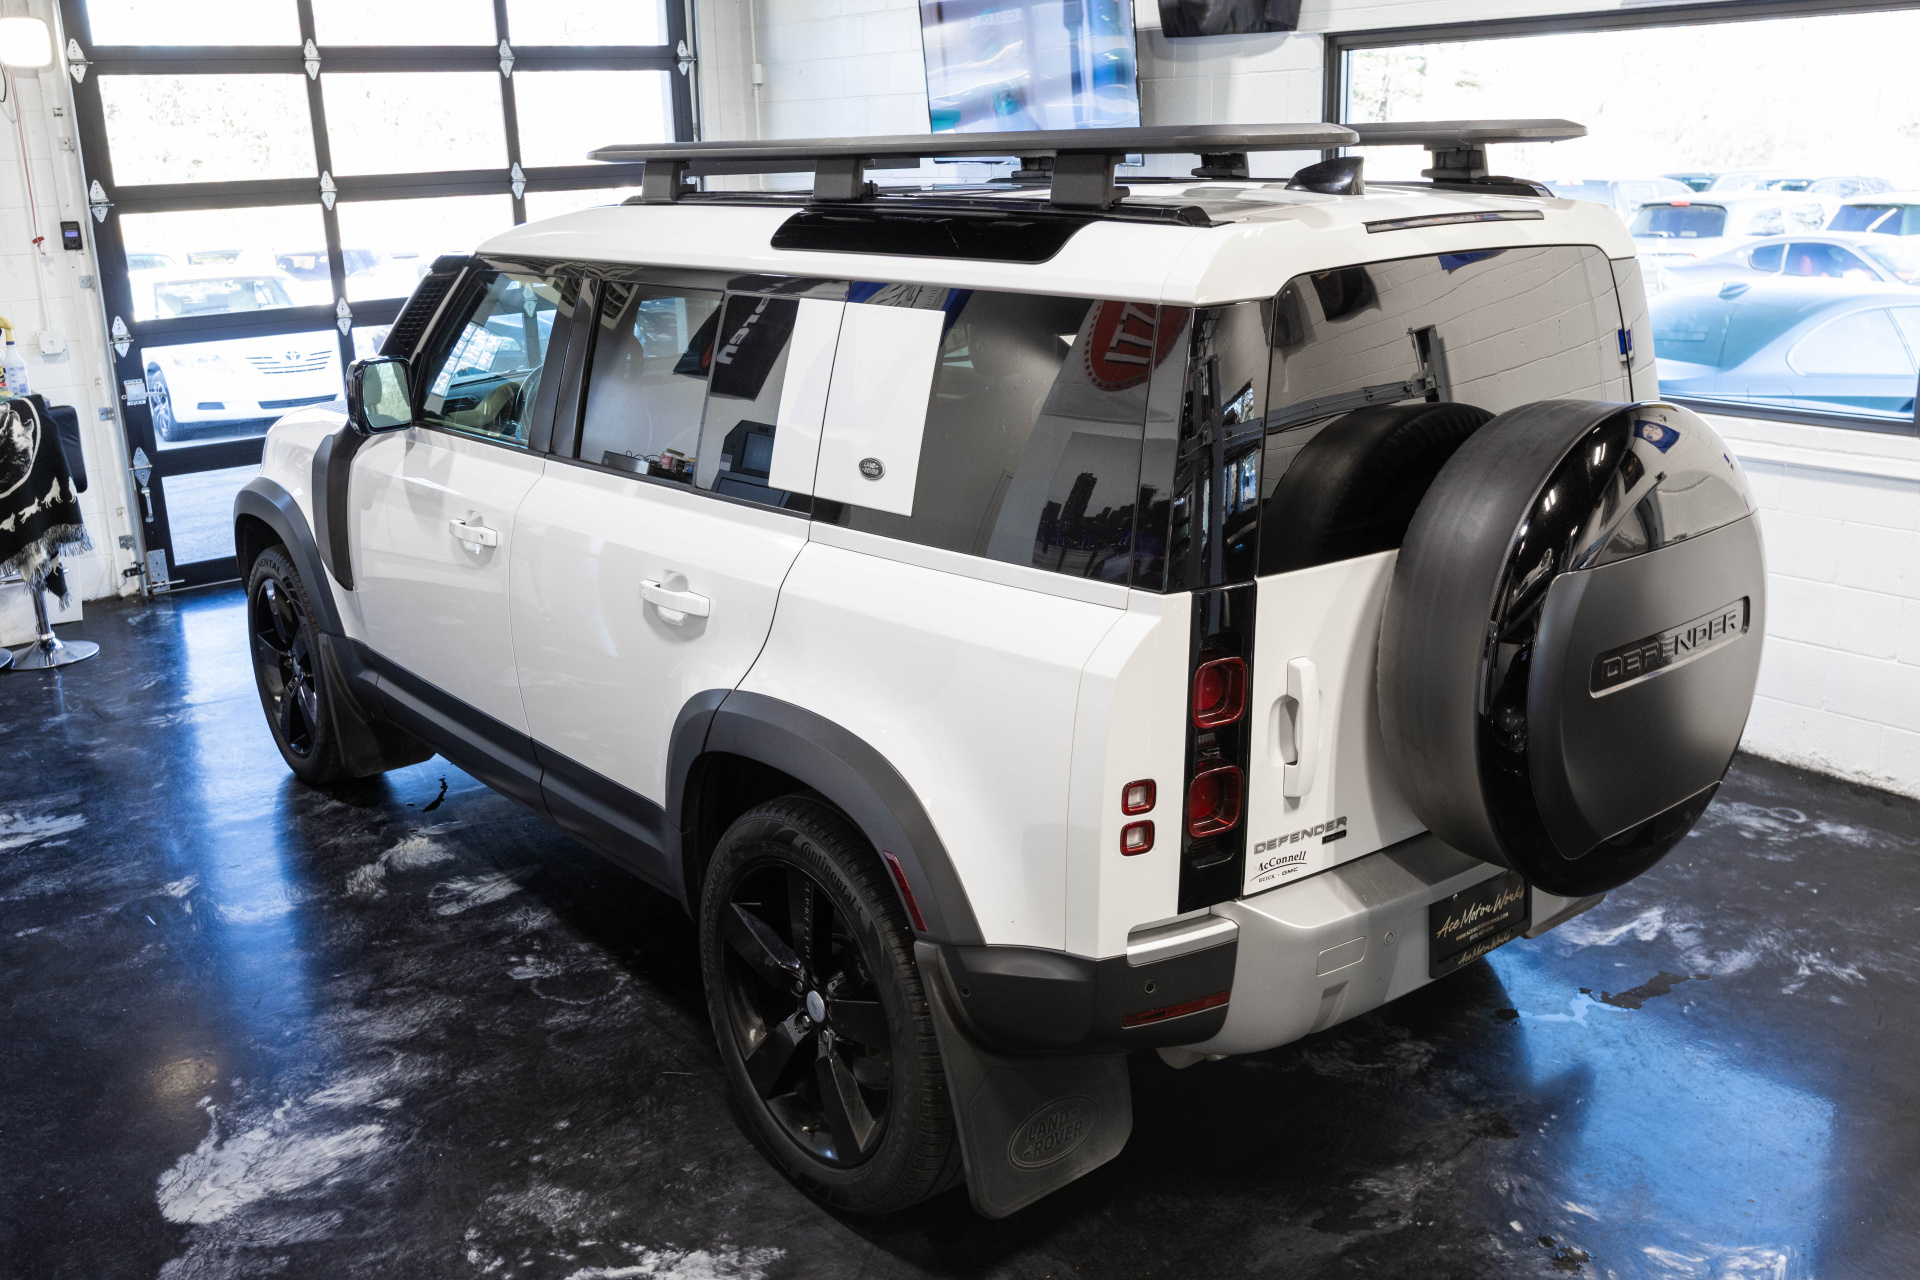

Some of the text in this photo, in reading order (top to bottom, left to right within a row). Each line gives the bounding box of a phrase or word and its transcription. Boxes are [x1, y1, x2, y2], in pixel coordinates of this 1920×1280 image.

[1602, 609, 1738, 682] DEFENDER
[1253, 816, 1348, 855] DEFENDER
[800, 841, 859, 906] Continental
[1436, 915, 1460, 939] Ace
[1027, 1110, 1070, 1142] LAND
[1032, 1120, 1084, 1157] ROVER
